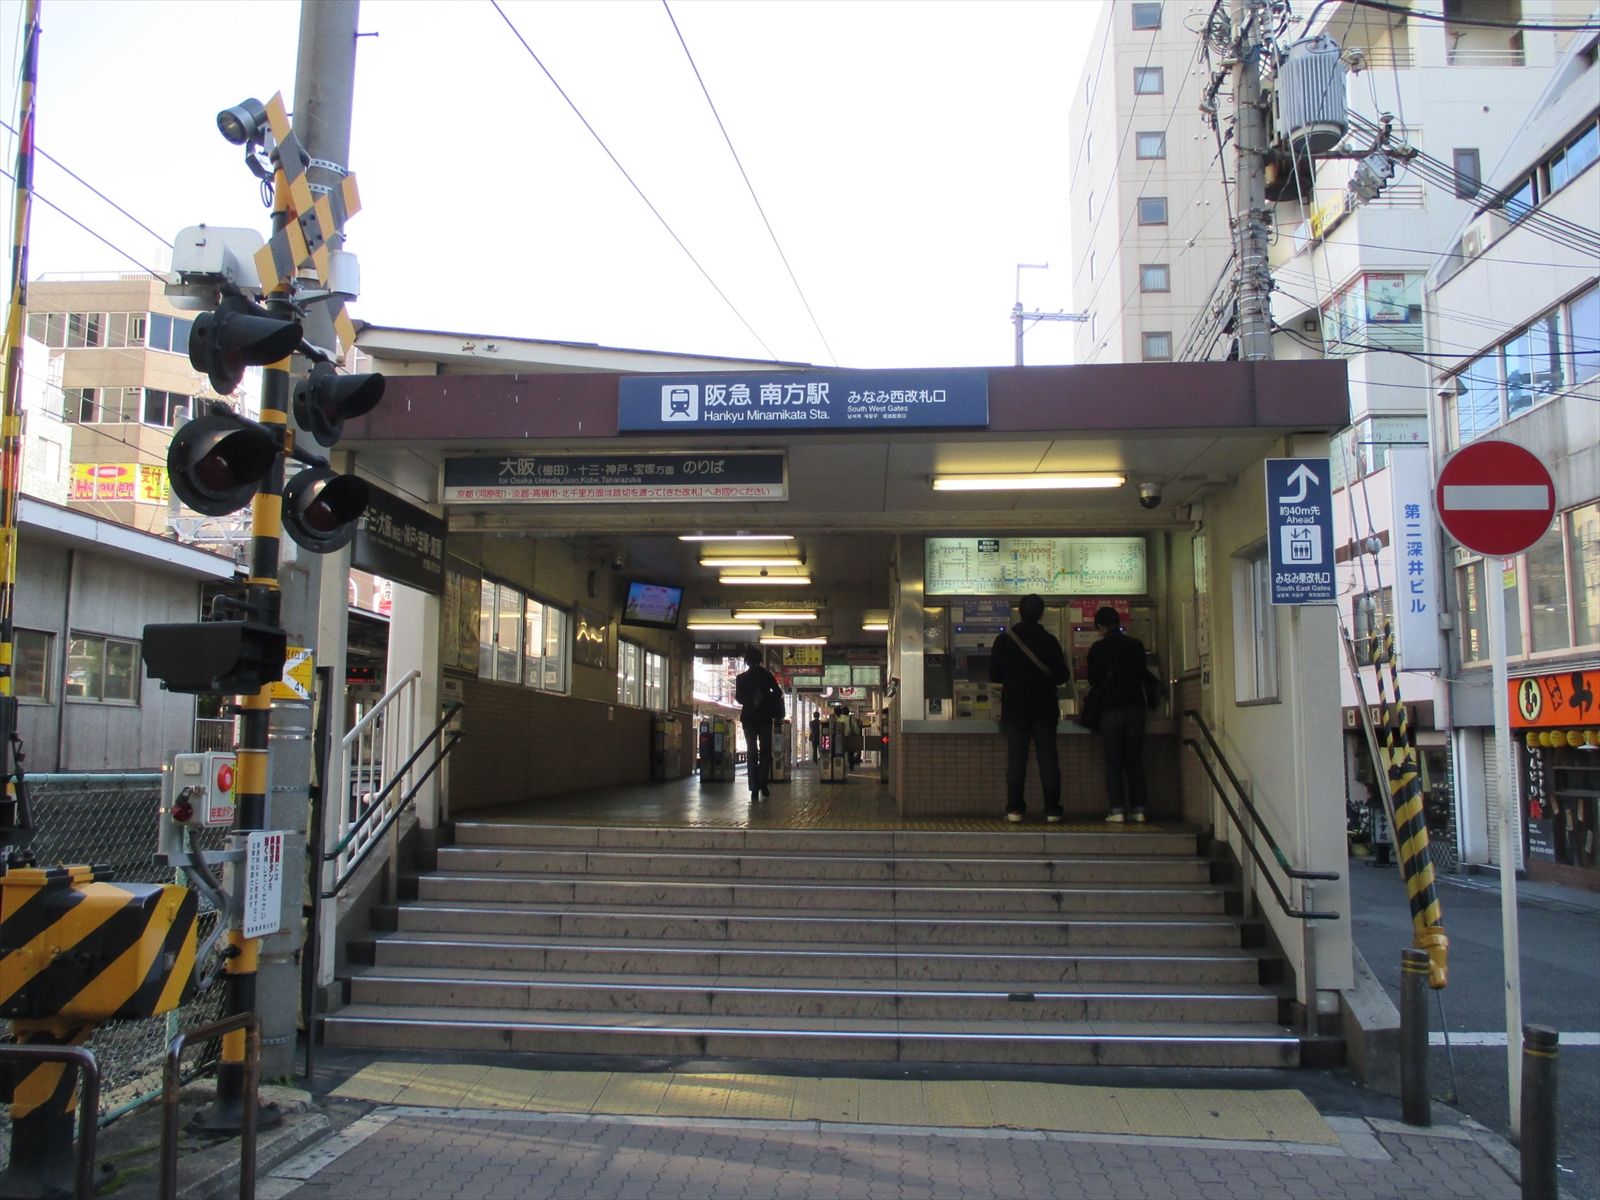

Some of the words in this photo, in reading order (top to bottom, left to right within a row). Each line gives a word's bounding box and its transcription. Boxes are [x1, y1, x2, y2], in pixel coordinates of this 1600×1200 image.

[704, 384, 752, 406] 阪急
[759, 382, 830, 405] 南方駅
[847, 389, 946, 404] みなみ西改札口
[887, 404, 908, 412] Gates
[704, 410, 744, 423] Hankyu
[746, 409, 807, 421] Minamikata
[809, 408, 830, 420] Sta.
[682, 460, 725, 475] のりば
[511, 477, 533, 485] Osaka
[1279, 506, 1321, 516] 約40m先
[1286, 516, 1315, 524] Ahead
[1404, 504, 1426, 613] 第二深井ビル
[1276, 572, 1330, 584] みなみ東改札口
